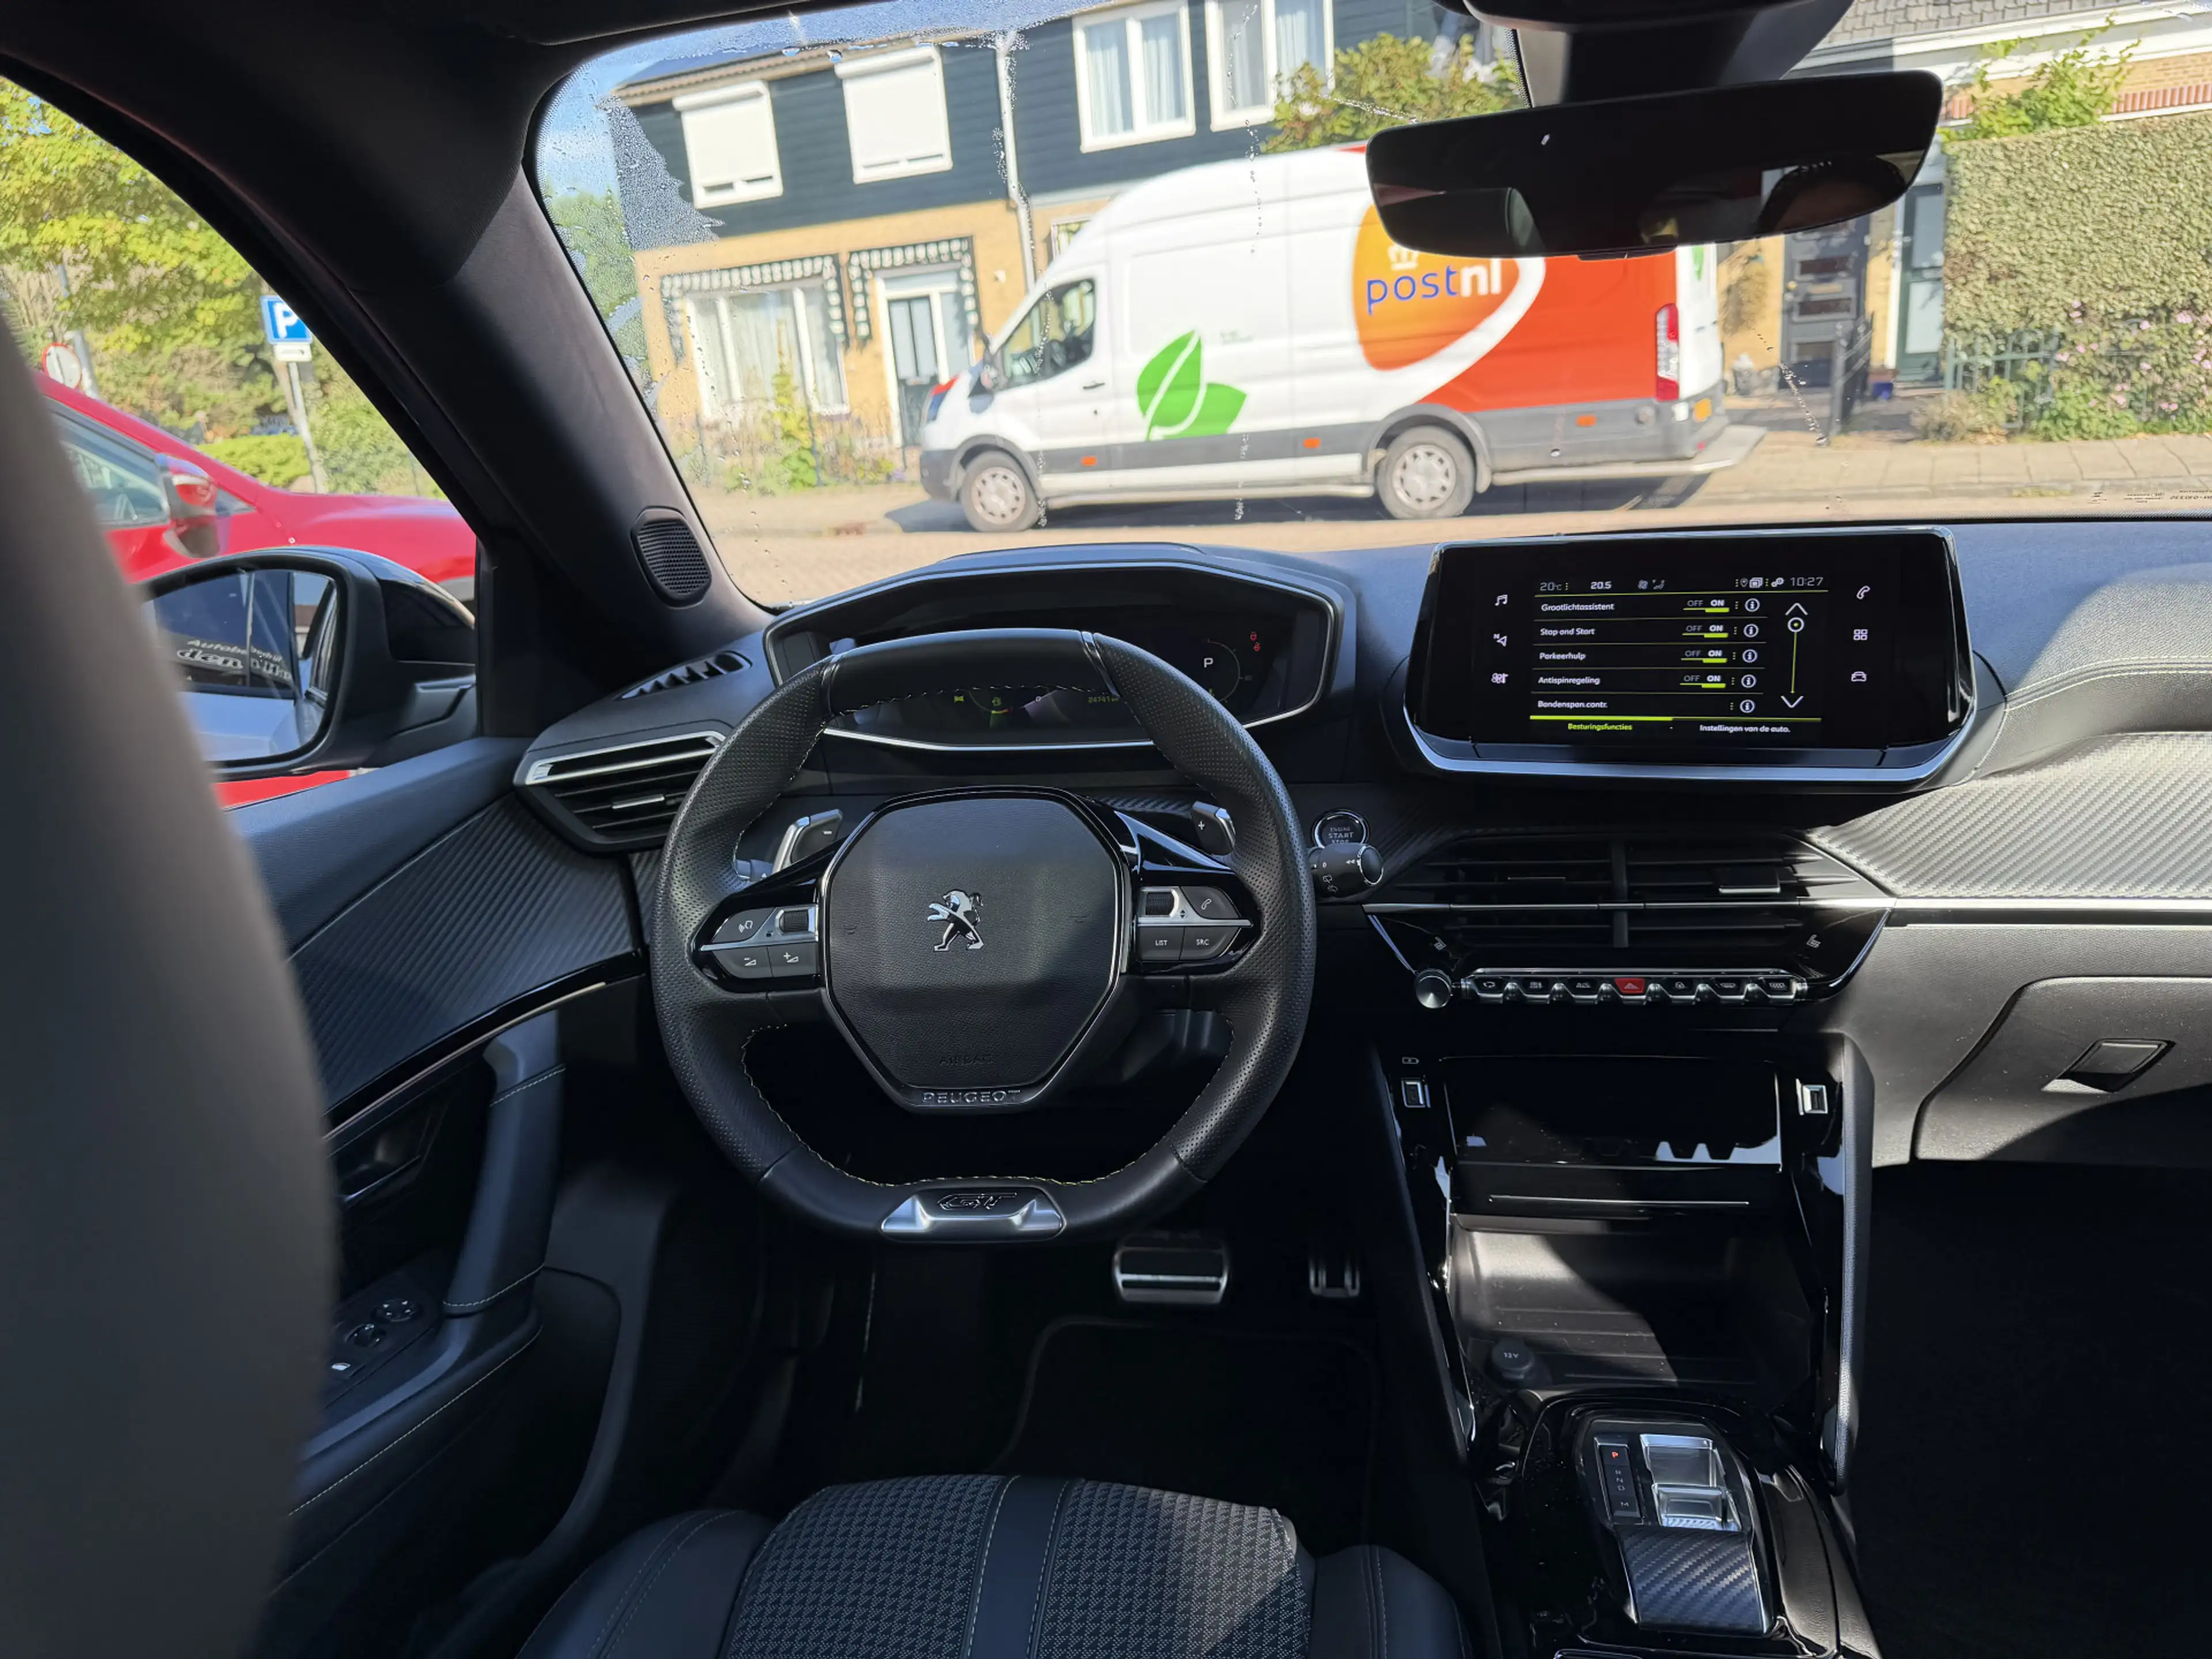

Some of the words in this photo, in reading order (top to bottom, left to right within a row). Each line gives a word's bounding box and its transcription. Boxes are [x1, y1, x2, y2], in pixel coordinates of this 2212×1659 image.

[1367, 257, 1501, 316] postnl
[273, 302, 299, 338] P
[1590, 581, 1612, 589] 20.5
[1790, 577, 1823, 586] 10:27
[1541, 603, 1615, 611] Grootlichtassistent
[1540, 628, 1558, 636] Stop
[1539, 652, 1586, 661] Parkeerhulp
[1203, 657, 1214, 668] P
[1538, 676, 1600, 685] Antispinregeling
[1567, 723, 1633, 731] Besturingsfuncties
[1699, 725, 1743, 733] Instellingen
[922, 1090, 1020, 1104] PEUGEOT
